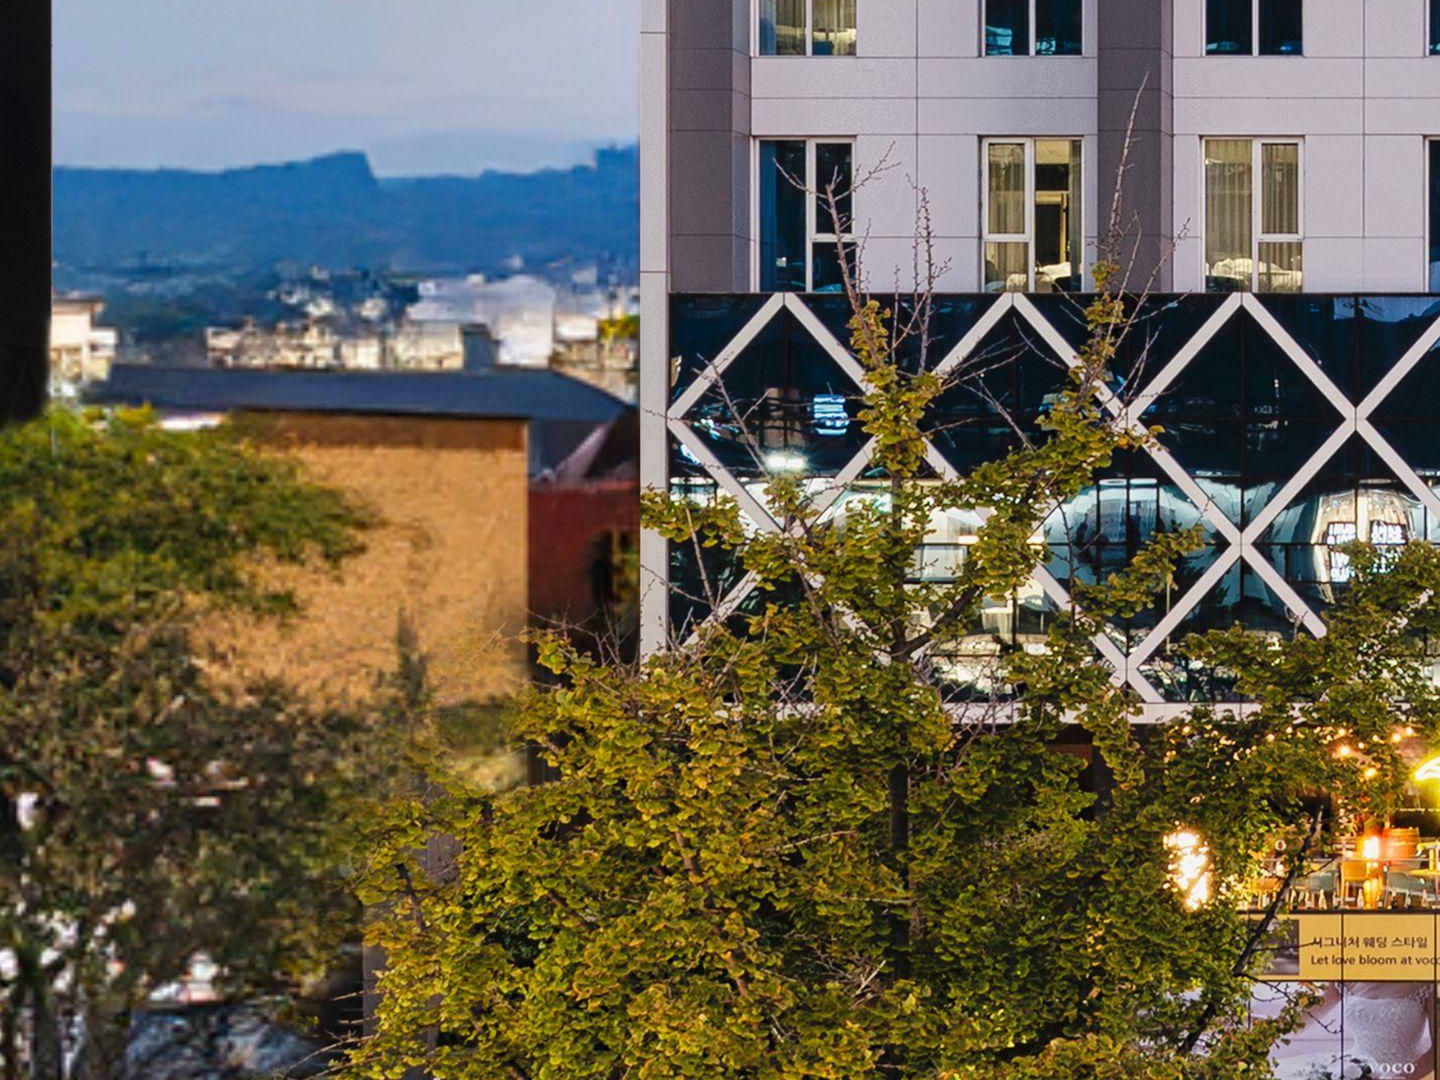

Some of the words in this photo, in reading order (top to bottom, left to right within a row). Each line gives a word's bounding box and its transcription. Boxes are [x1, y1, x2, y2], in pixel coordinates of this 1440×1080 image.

[1363, 936, 1387, 948] 웨딩
[1391, 936, 1428, 948] 스타일
[1311, 955, 1329, 965] Let
[1332, 954, 1356, 965] love
[1359, 954, 1397, 965] bloom
[1400, 955, 1412, 965] at
